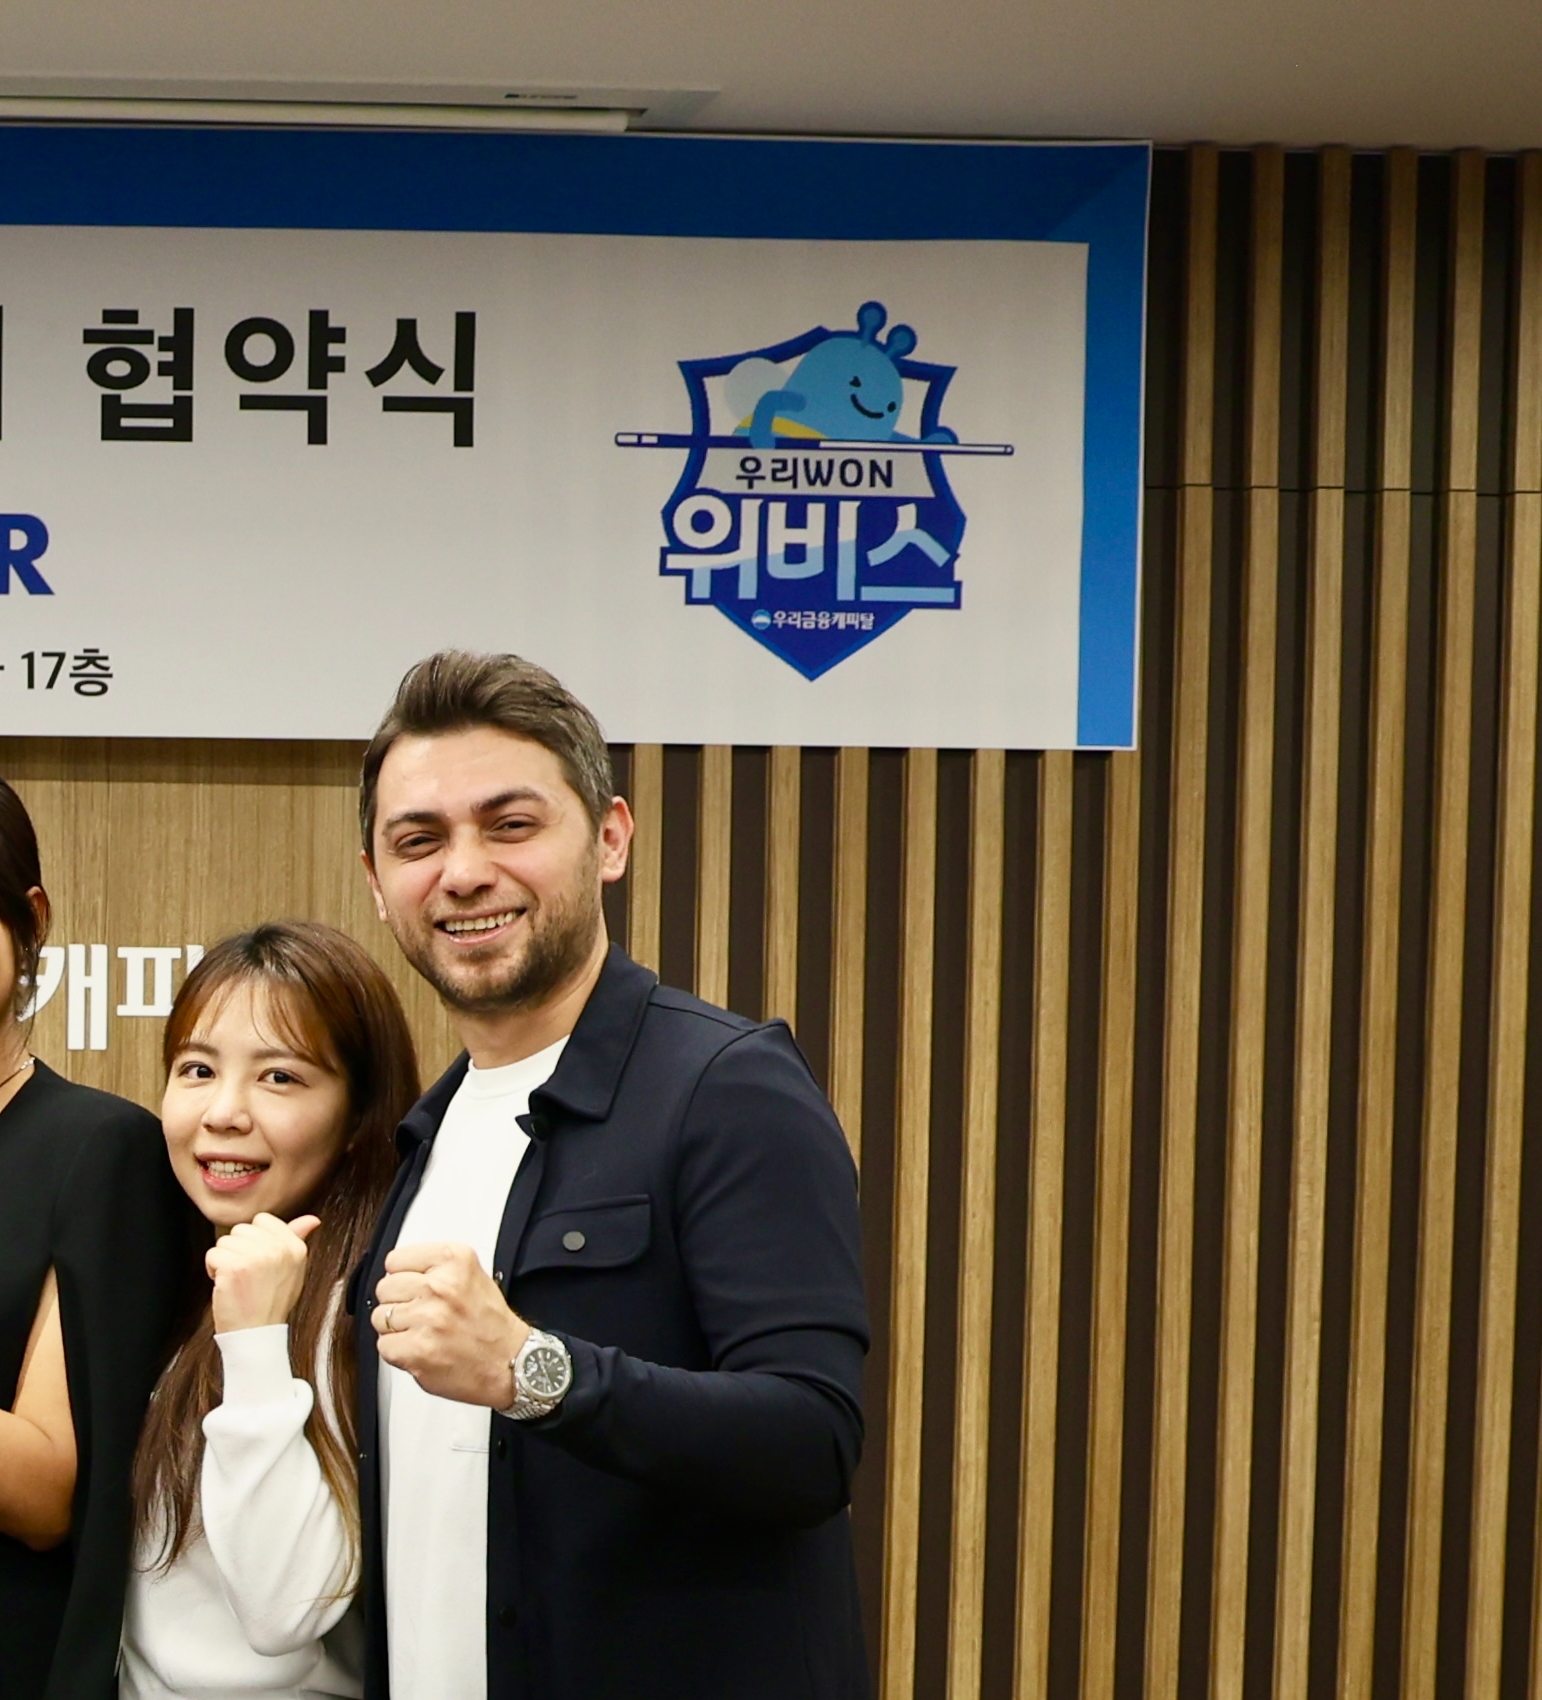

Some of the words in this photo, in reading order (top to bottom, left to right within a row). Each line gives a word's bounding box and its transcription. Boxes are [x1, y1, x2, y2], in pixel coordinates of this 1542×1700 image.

[82, 306, 477, 448] 협약식
[735, 456, 893, 490] 우리WON
[666, 493, 956, 603] 위비스
[773, 610, 875, 630] 우리금융캐피탈
[21, 648, 113, 697] 17층
